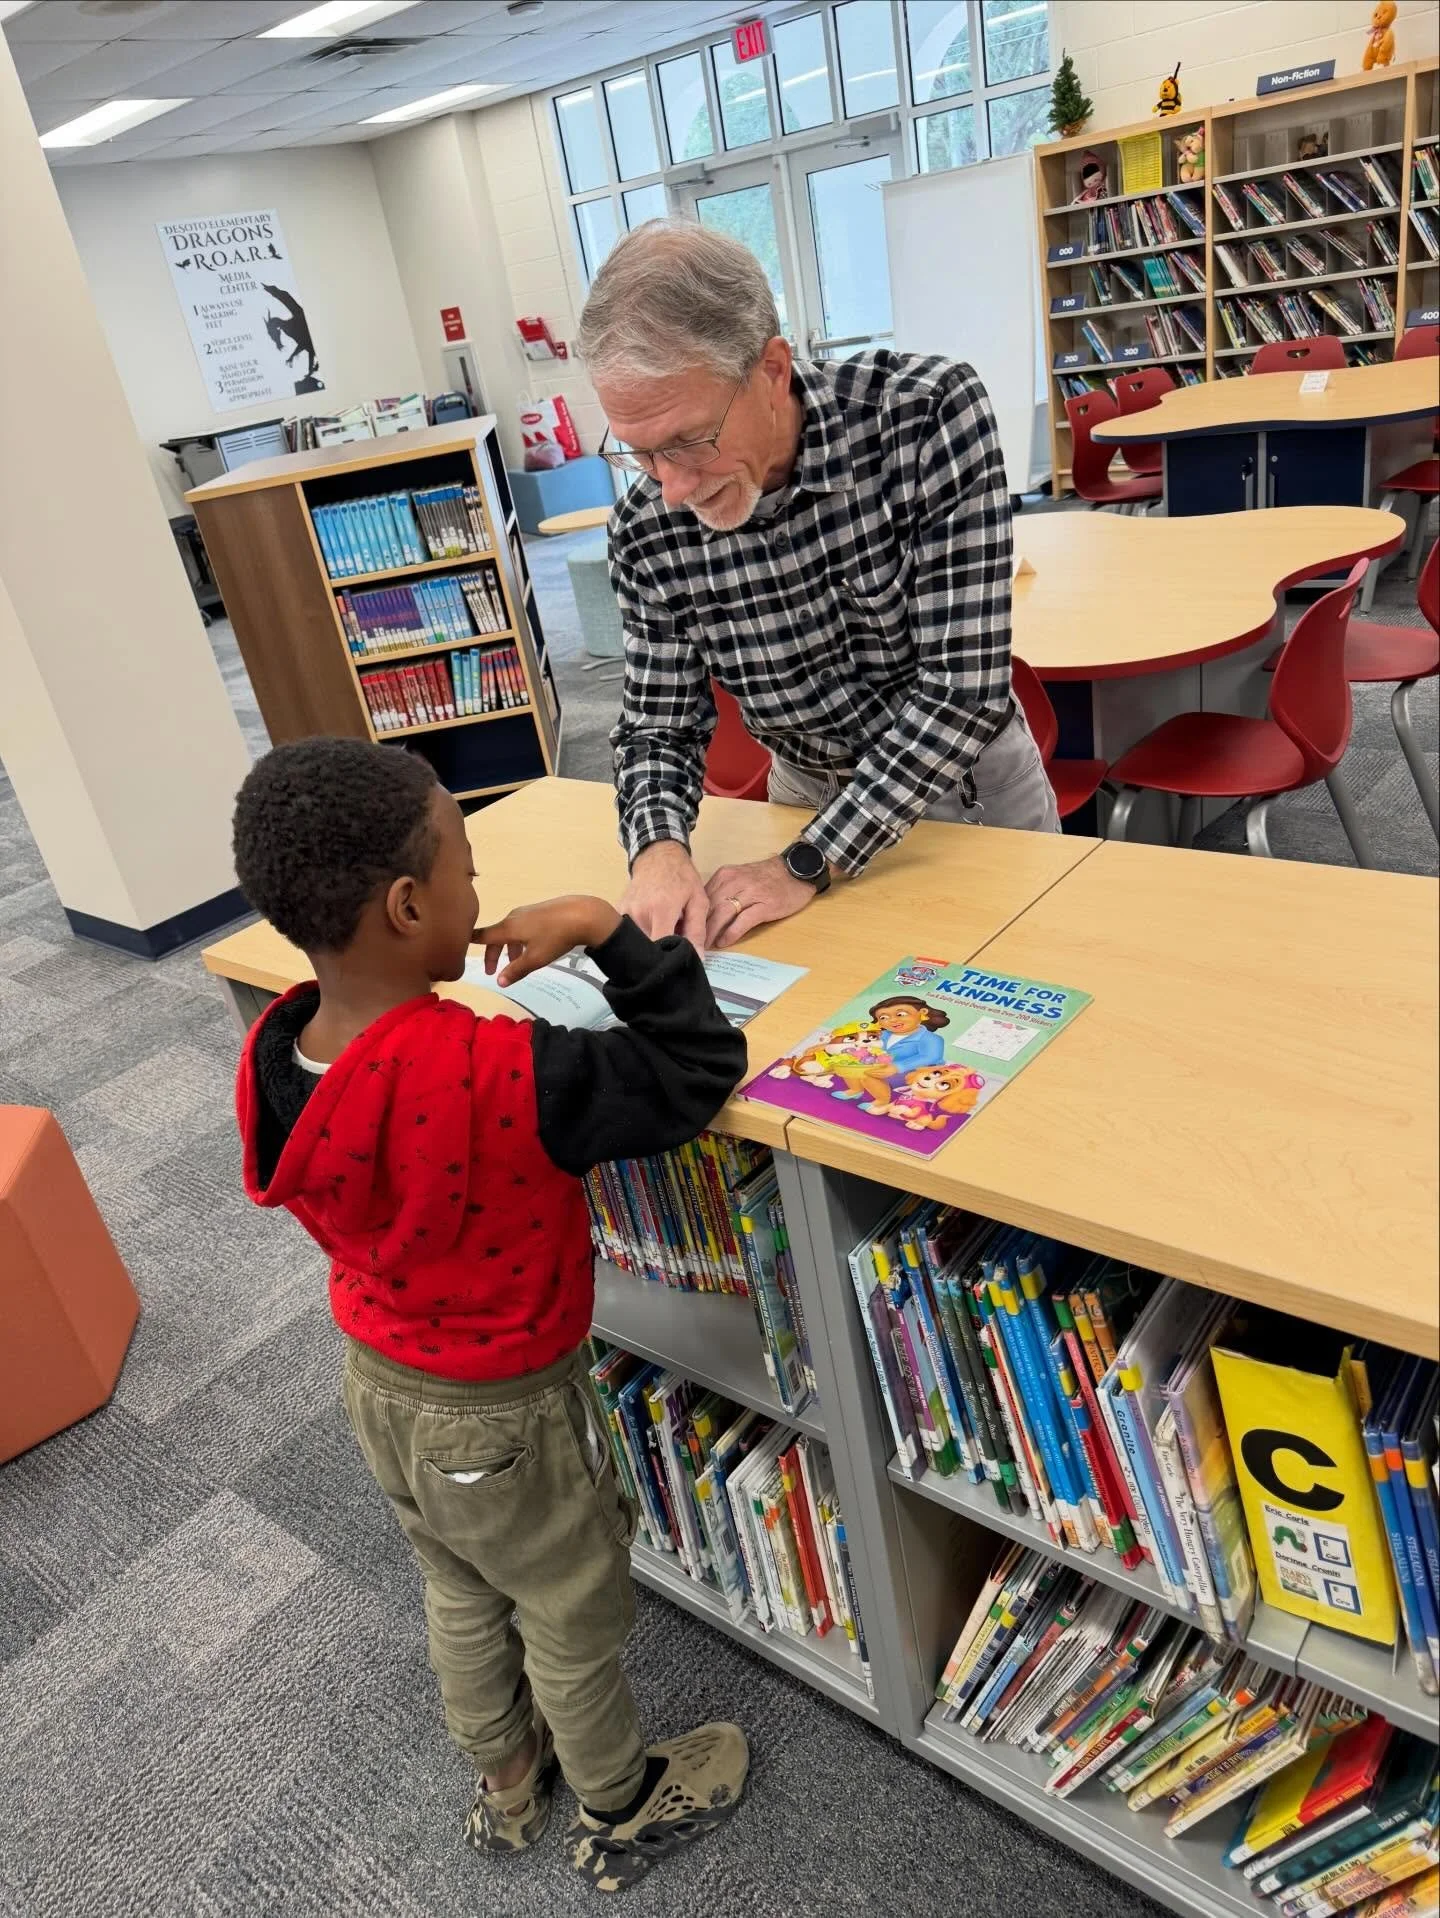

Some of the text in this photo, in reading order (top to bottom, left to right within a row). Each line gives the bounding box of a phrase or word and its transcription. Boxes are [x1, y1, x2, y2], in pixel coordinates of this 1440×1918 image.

[736, 21, 765, 60] EXIT
[1271, 68, 1320, 85] Non-Fiction
[163, 213, 271, 235] DESOTO ELEMENTARY
[169, 223, 274, 251] DRAGONS
[193, 246, 267, 271] R.O.A.R.
[1059, 246, 1074, 255] 000
[218, 271, 251, 284] MEDIA
[219, 281, 258, 295] CENTER
[1062, 298, 1076, 307] 100
[1420, 311, 1439, 320] 400
[203, 343, 213, 355] 2
[215, 380, 224, 394] 3
[960, 969, 1067, 1003] TIME FOR
[935, 979, 1063, 1019] KINDNESS
[1115, 1409, 1136, 1455] Granite
[1240, 1428, 1345, 1511] C
[1264, 1503, 1310, 1526] Eric Carle
[1173, 1494, 1210, 1595] The Very Hungry Caterpillar
[1391, 1531, 1412, 1585] STELLALUNA
[1405, 1534, 1425, 1588] STELLALUNA
